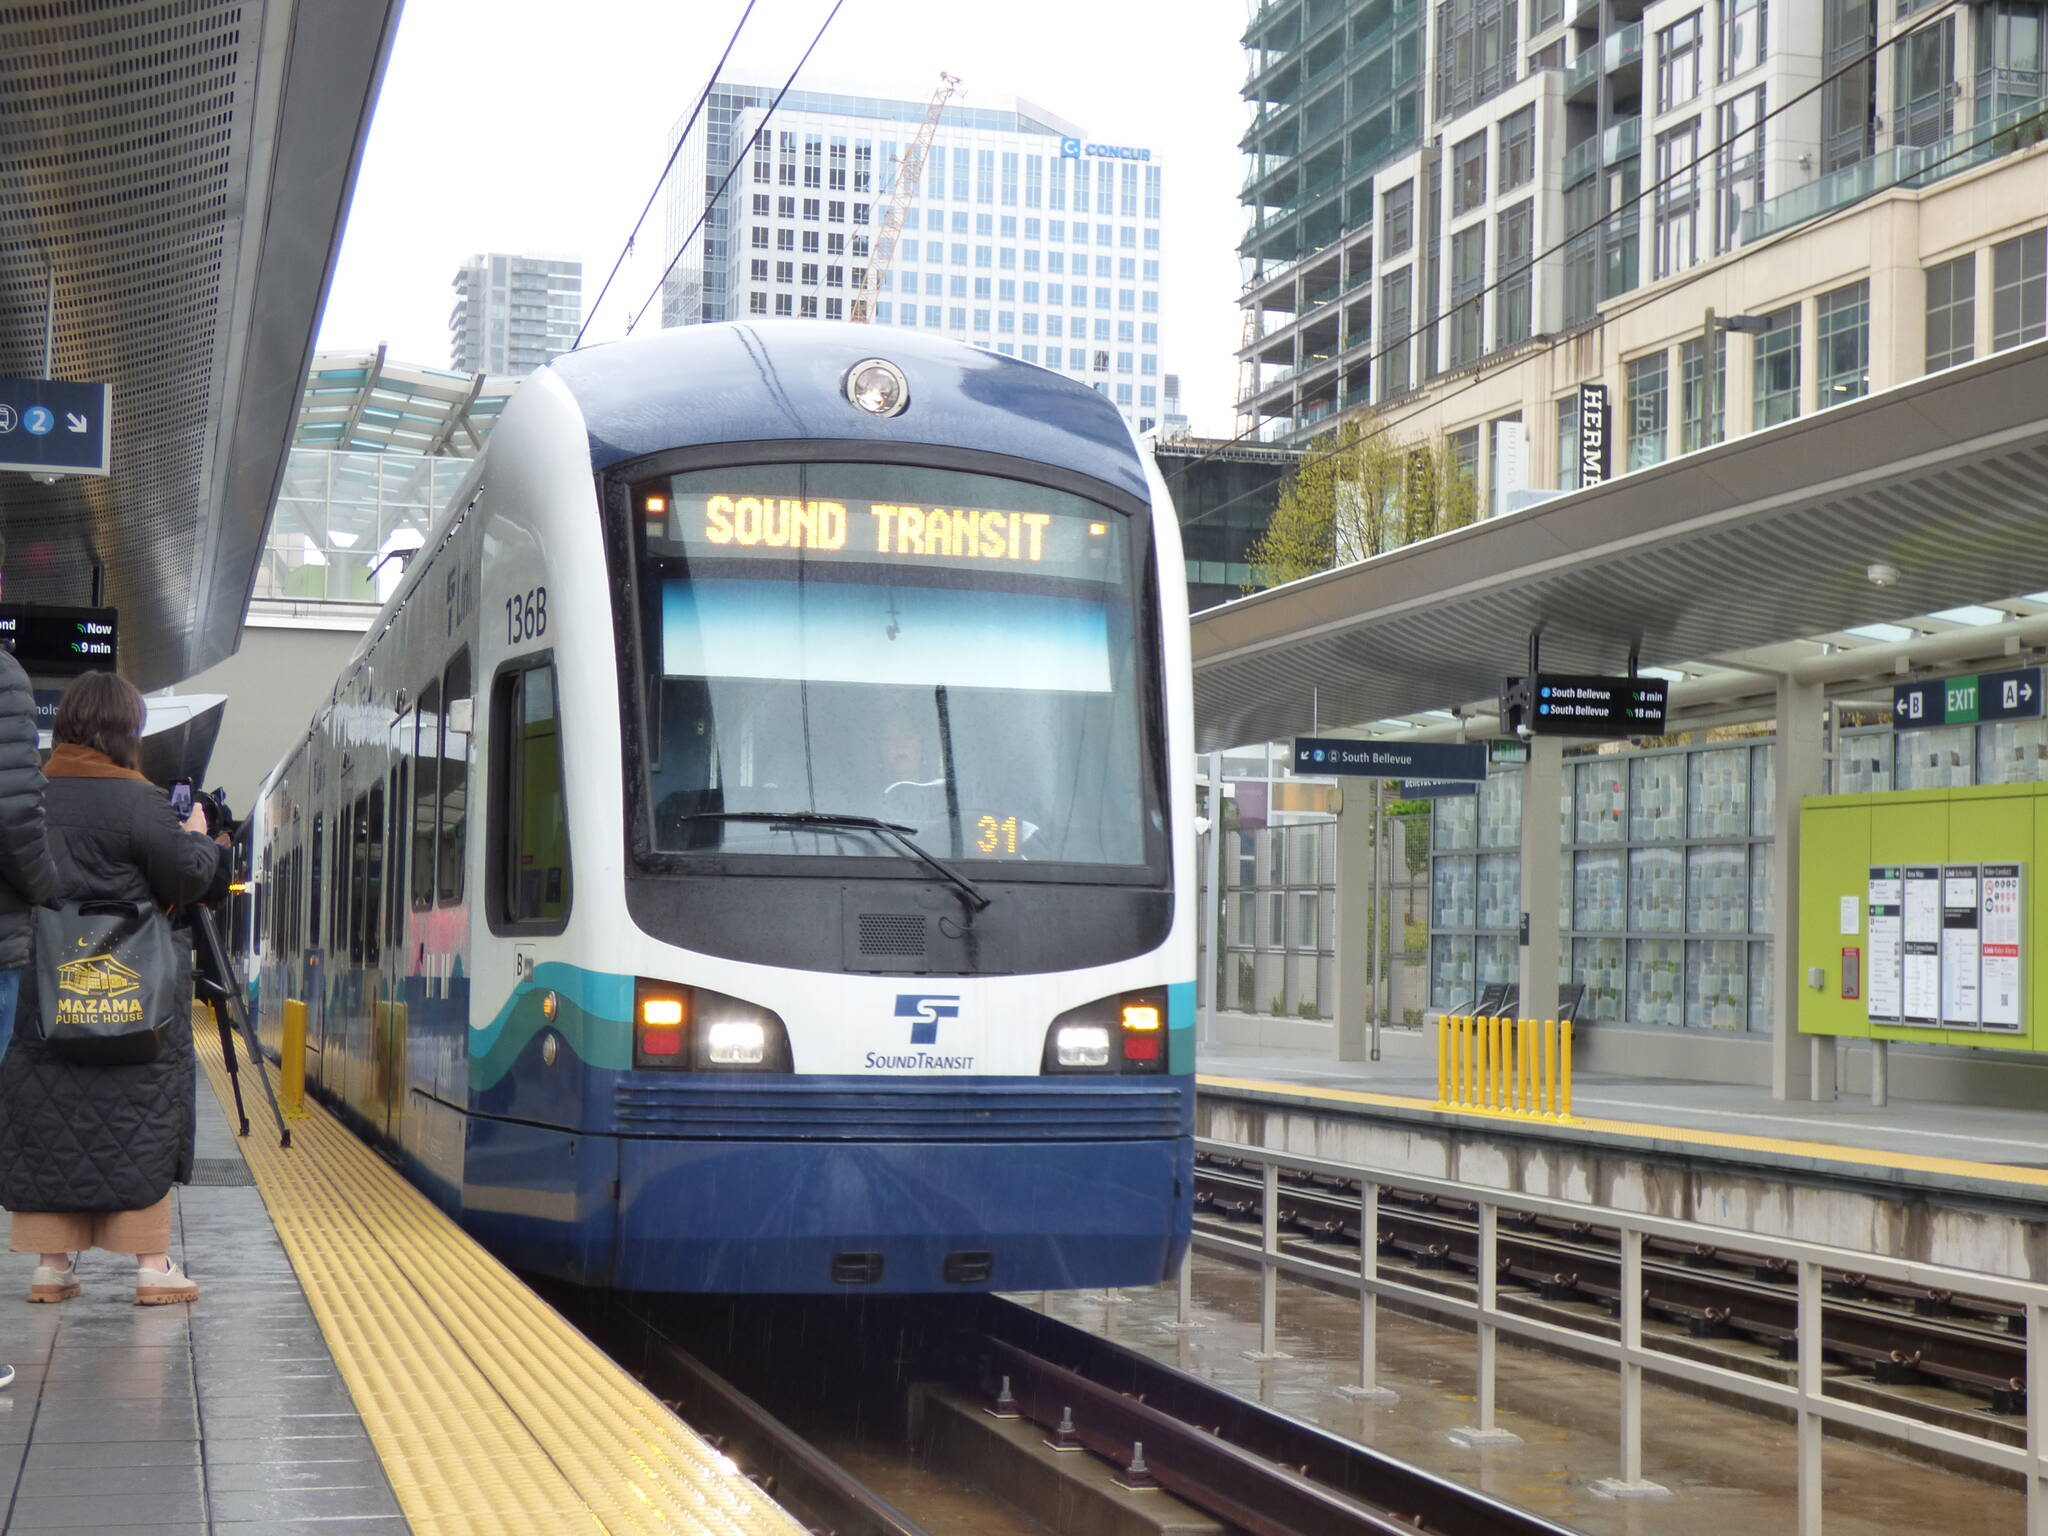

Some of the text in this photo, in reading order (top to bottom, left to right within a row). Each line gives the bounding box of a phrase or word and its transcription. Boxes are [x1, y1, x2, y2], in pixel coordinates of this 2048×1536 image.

[1085, 144, 1151, 161] CONCUR
[32, 410, 47, 432] 2
[705, 495, 1050, 562] SOUND TRANSIT
[506, 586, 547, 646] 136B
[87, 622, 112, 635] Now
[81, 642, 111, 654] 9 min
[1551, 687, 1575, 698] South
[1577, 688, 1611, 700] Bellevue
[1640, 691, 1646, 702] 8
[1646, 692, 1663, 702] min
[1913, 685, 2015, 714] B EXIT A
[1550, 705, 1575, 715] South
[1575, 705, 1610, 717] Bellevue
[1634, 708, 1644, 719] 18
[1645, 709, 1661, 719] min
[1342, 752, 1370, 764] South
[1372, 753, 1412, 765] Bellevue
[976, 815, 1017, 854] 31
[517, 952, 523, 976] B
[57, 998, 143, 1014] MAZAMA
[55, 1011, 144, 1025] PUBLIC HOUSE
